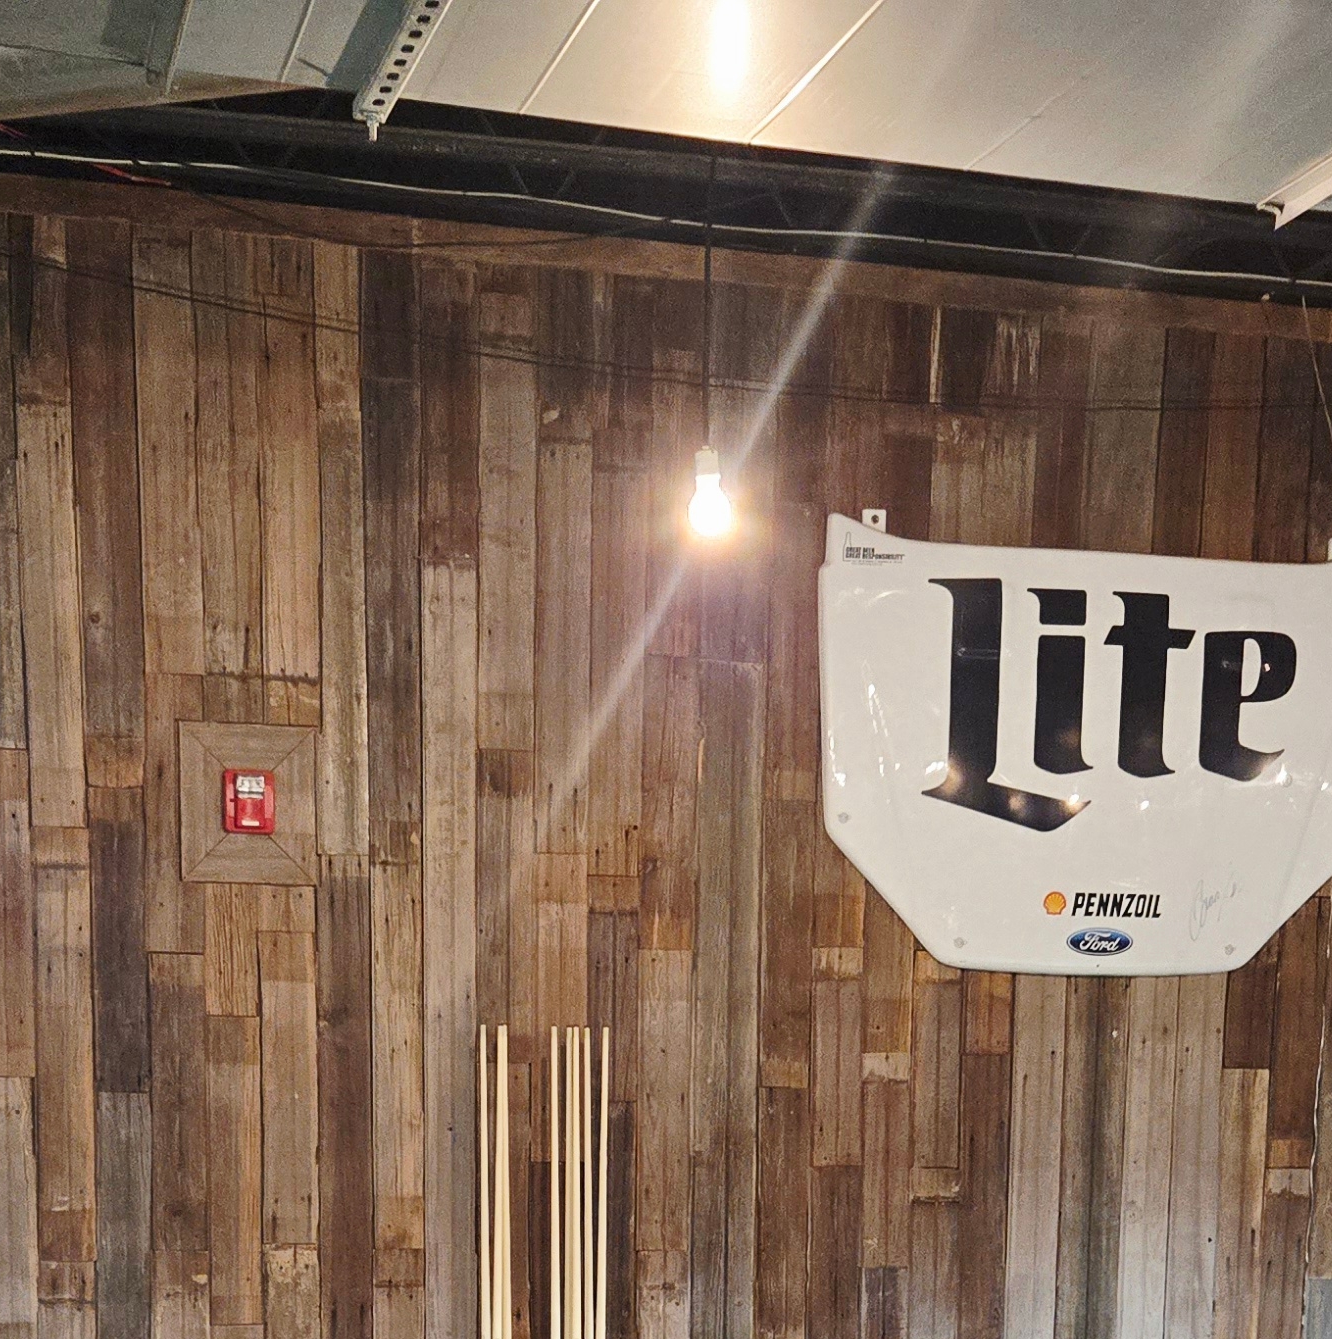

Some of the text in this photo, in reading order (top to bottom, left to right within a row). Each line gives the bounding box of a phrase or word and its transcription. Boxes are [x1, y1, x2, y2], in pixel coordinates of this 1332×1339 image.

[921, 578, 1297, 832] Lite
[1071, 892, 1162, 919] PENNZOIL
[1078, 931, 1121, 952] Ford
